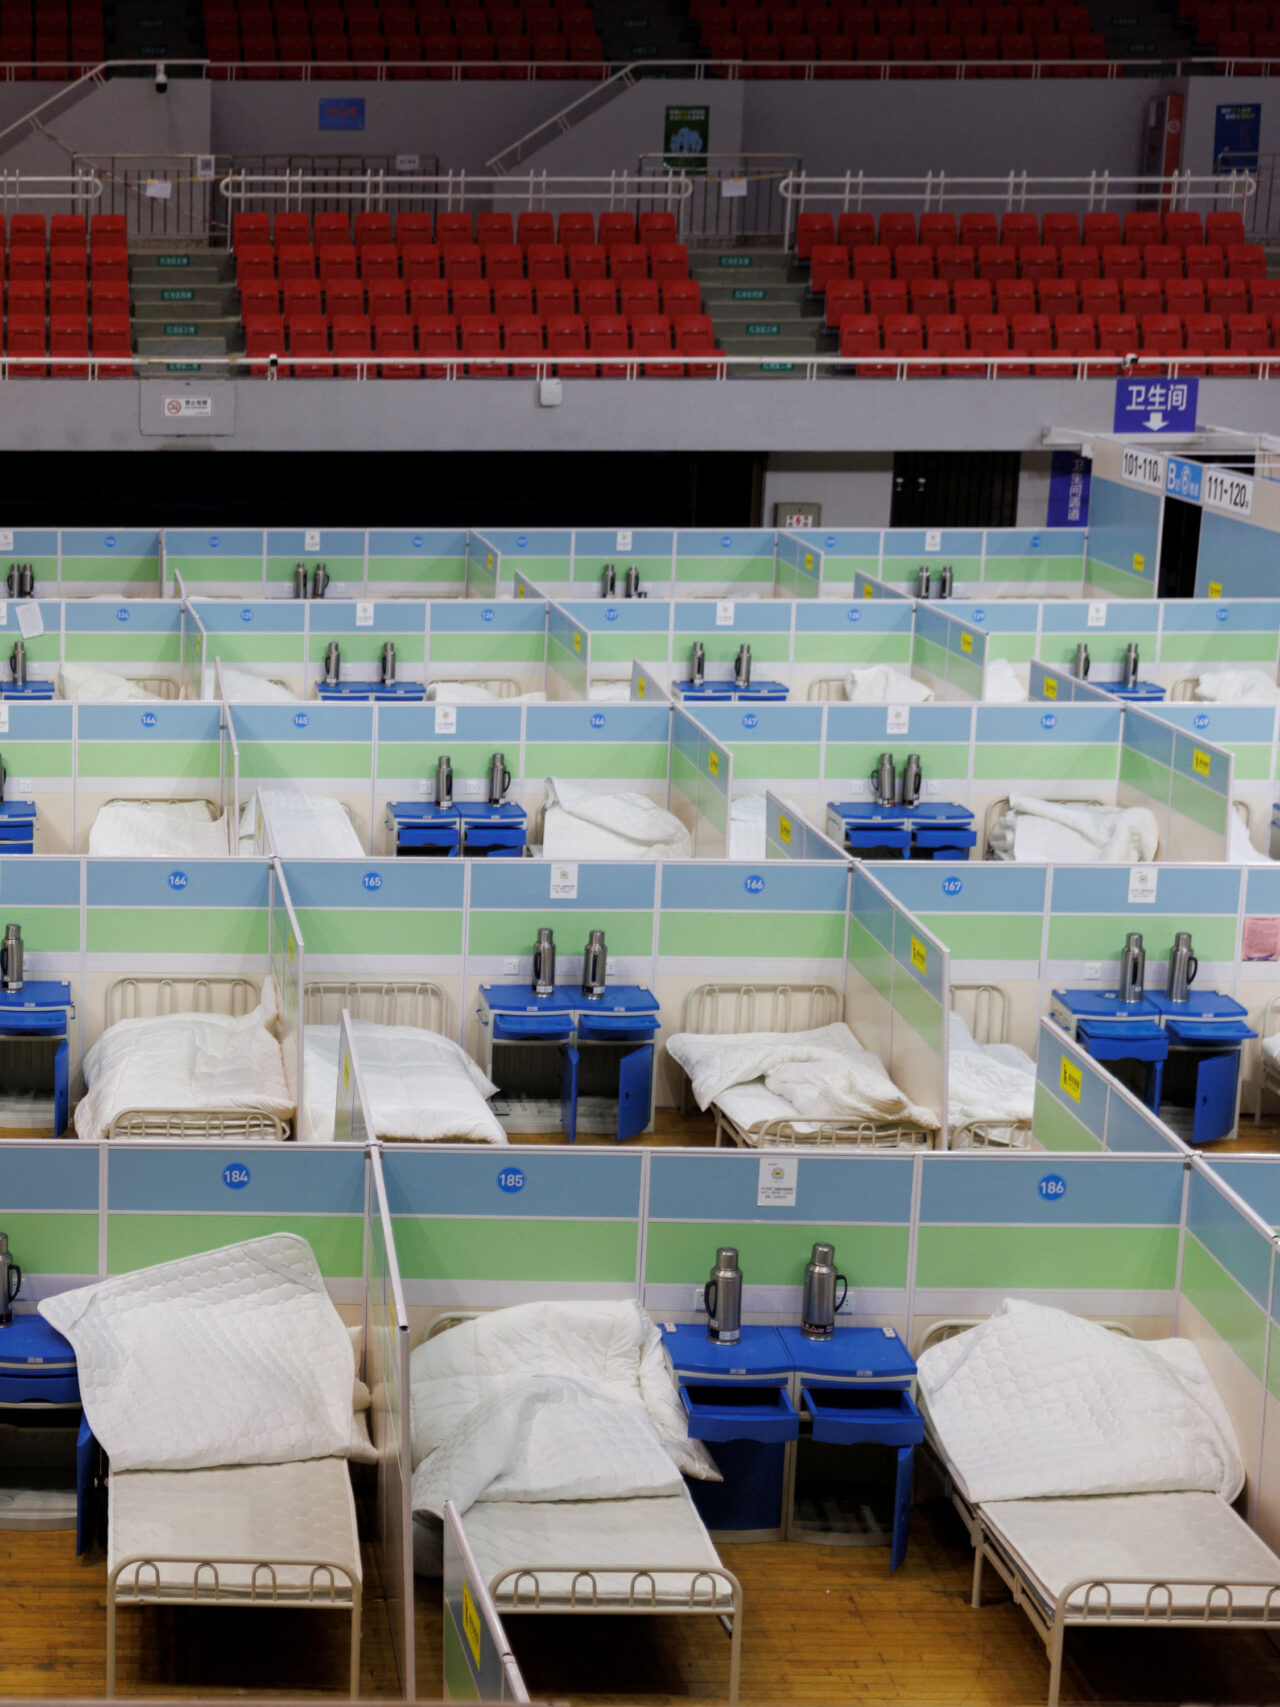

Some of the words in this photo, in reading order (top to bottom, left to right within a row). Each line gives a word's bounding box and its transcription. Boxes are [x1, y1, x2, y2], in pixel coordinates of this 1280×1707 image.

[1125, 383, 1188, 412] 卫生间
[142, 716, 156, 724] 144
[294, 716, 308, 724] 145
[591, 717, 605, 725] 146
[743, 717, 757, 725] 147
[1041, 718, 1055, 726] 148
[1195, 718, 1209, 726] 149
[169, 876, 186, 886] 164
[363, 877, 381, 887] 165
[746, 879, 763, 889] 166
[943, 881, 961, 891] 167
[225, 1170, 249, 1182] 184
[499, 1174, 523, 1187] 185
[1040, 1181, 1064, 1195] 186
